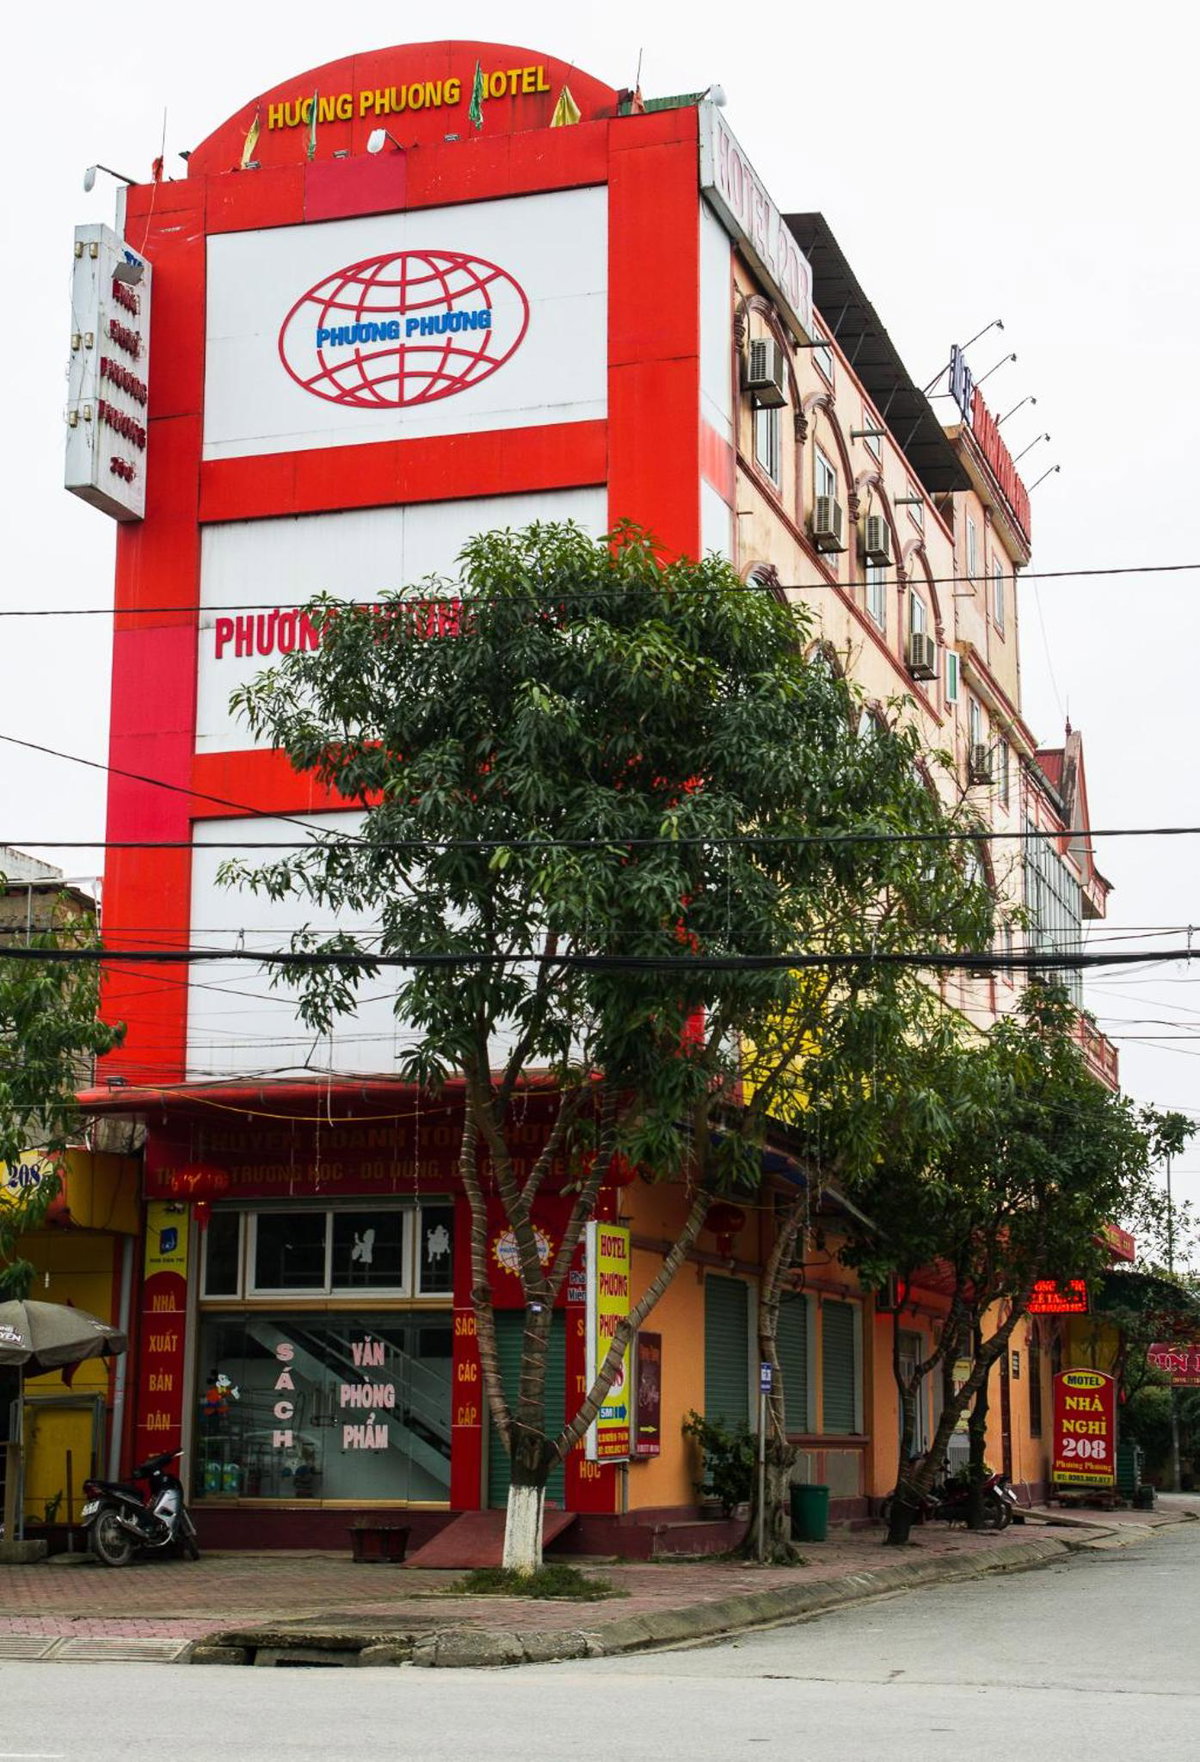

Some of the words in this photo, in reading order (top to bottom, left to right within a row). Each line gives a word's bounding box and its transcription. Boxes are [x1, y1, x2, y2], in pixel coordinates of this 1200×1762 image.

[716, 120, 776, 273] HOTEL
[317, 319, 400, 349] PHƯƠNG
[406, 309, 492, 337] PHƯƠNG
[215, 606, 329, 659] PHƯƠN
[601, 1234, 626, 1259] HOTEL
[351, 1335, 385, 1366] VĂN
[458, 1359, 477, 1382] CÁC
[1067, 1374, 1101, 1387] MOTEL
[273, 1342, 296, 1448] SÁCH
[340, 1375, 396, 1408] PHÒNG
[1065, 1394, 1104, 1412] NHÀ
[343, 1411, 389, 1449] PHẨM
[1062, 1417, 1107, 1435] NGHỈ
[1062, 1438, 1107, 1459] 208
